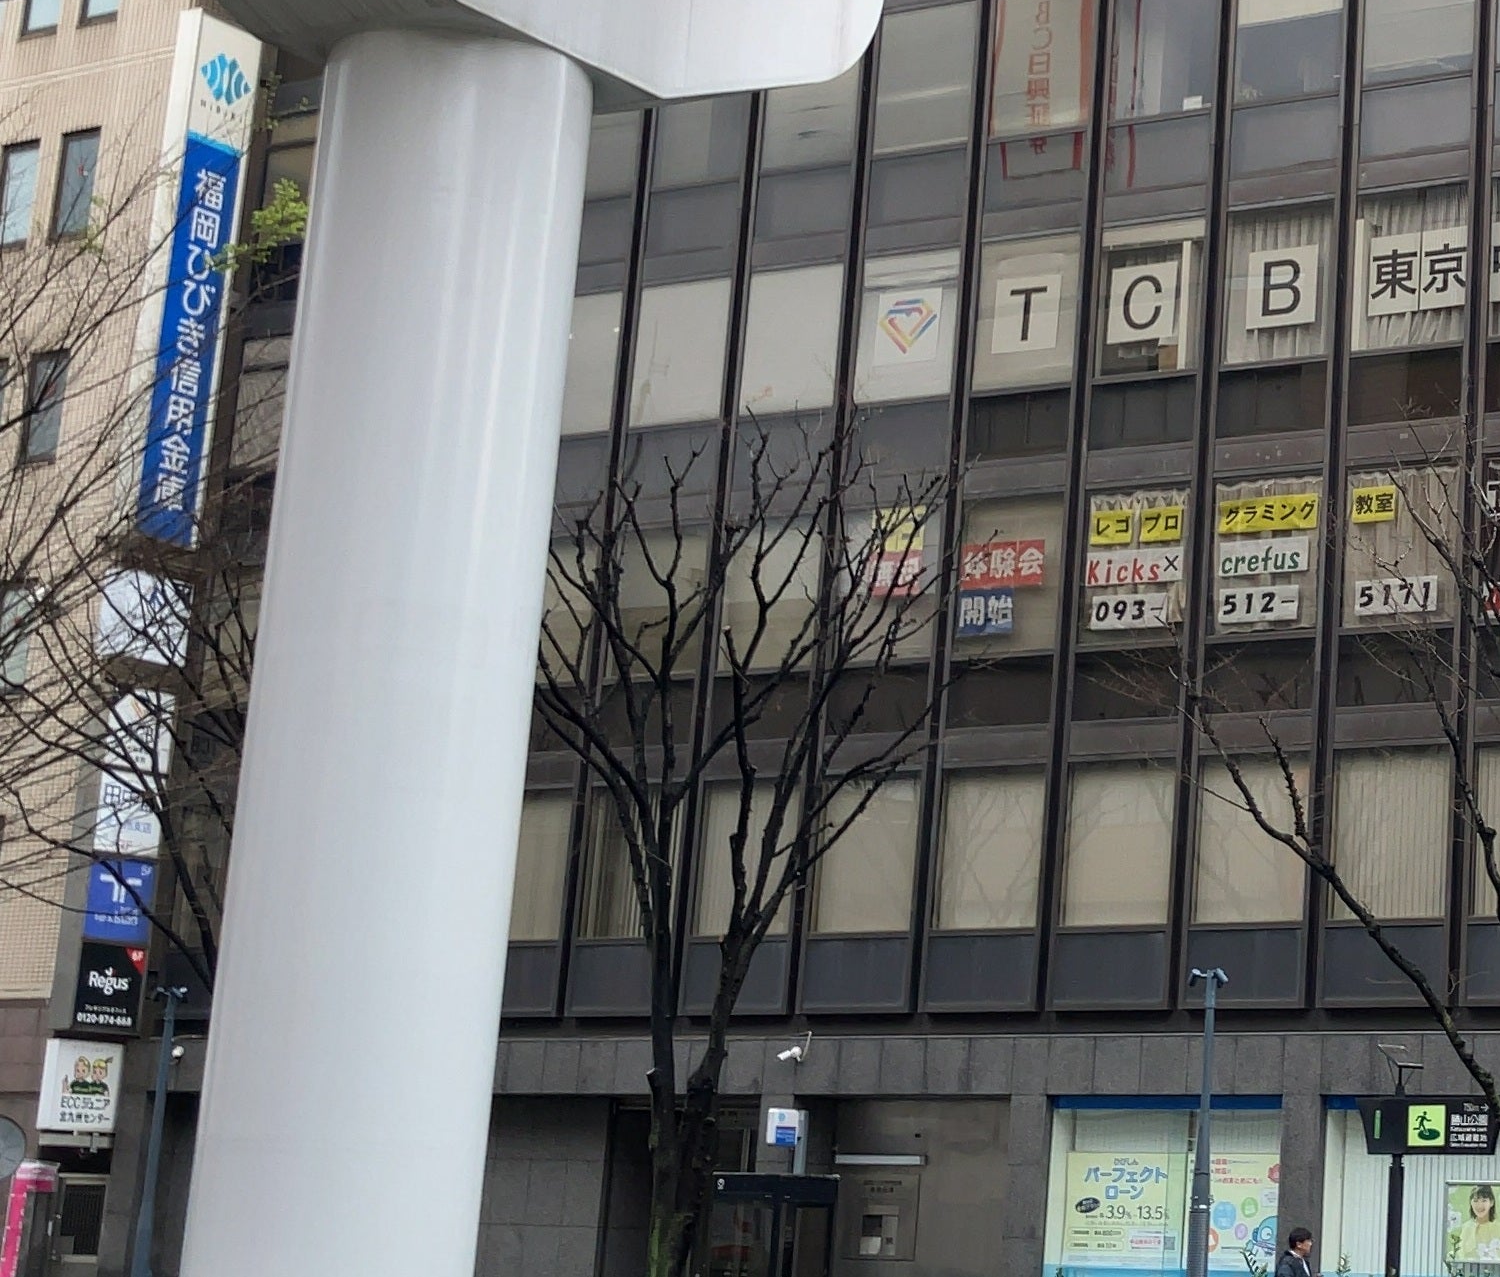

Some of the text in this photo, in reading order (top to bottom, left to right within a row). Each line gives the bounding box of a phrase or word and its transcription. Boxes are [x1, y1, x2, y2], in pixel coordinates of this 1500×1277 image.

[154, 168, 228, 512] 福岡ひびき信用金庫
[1221, 547, 1300, 574] crefus
[958, 594, 1013, 628] 開始
[88, 967, 129, 996] Regus
[1105, 1185, 1144, 1200] ローン
